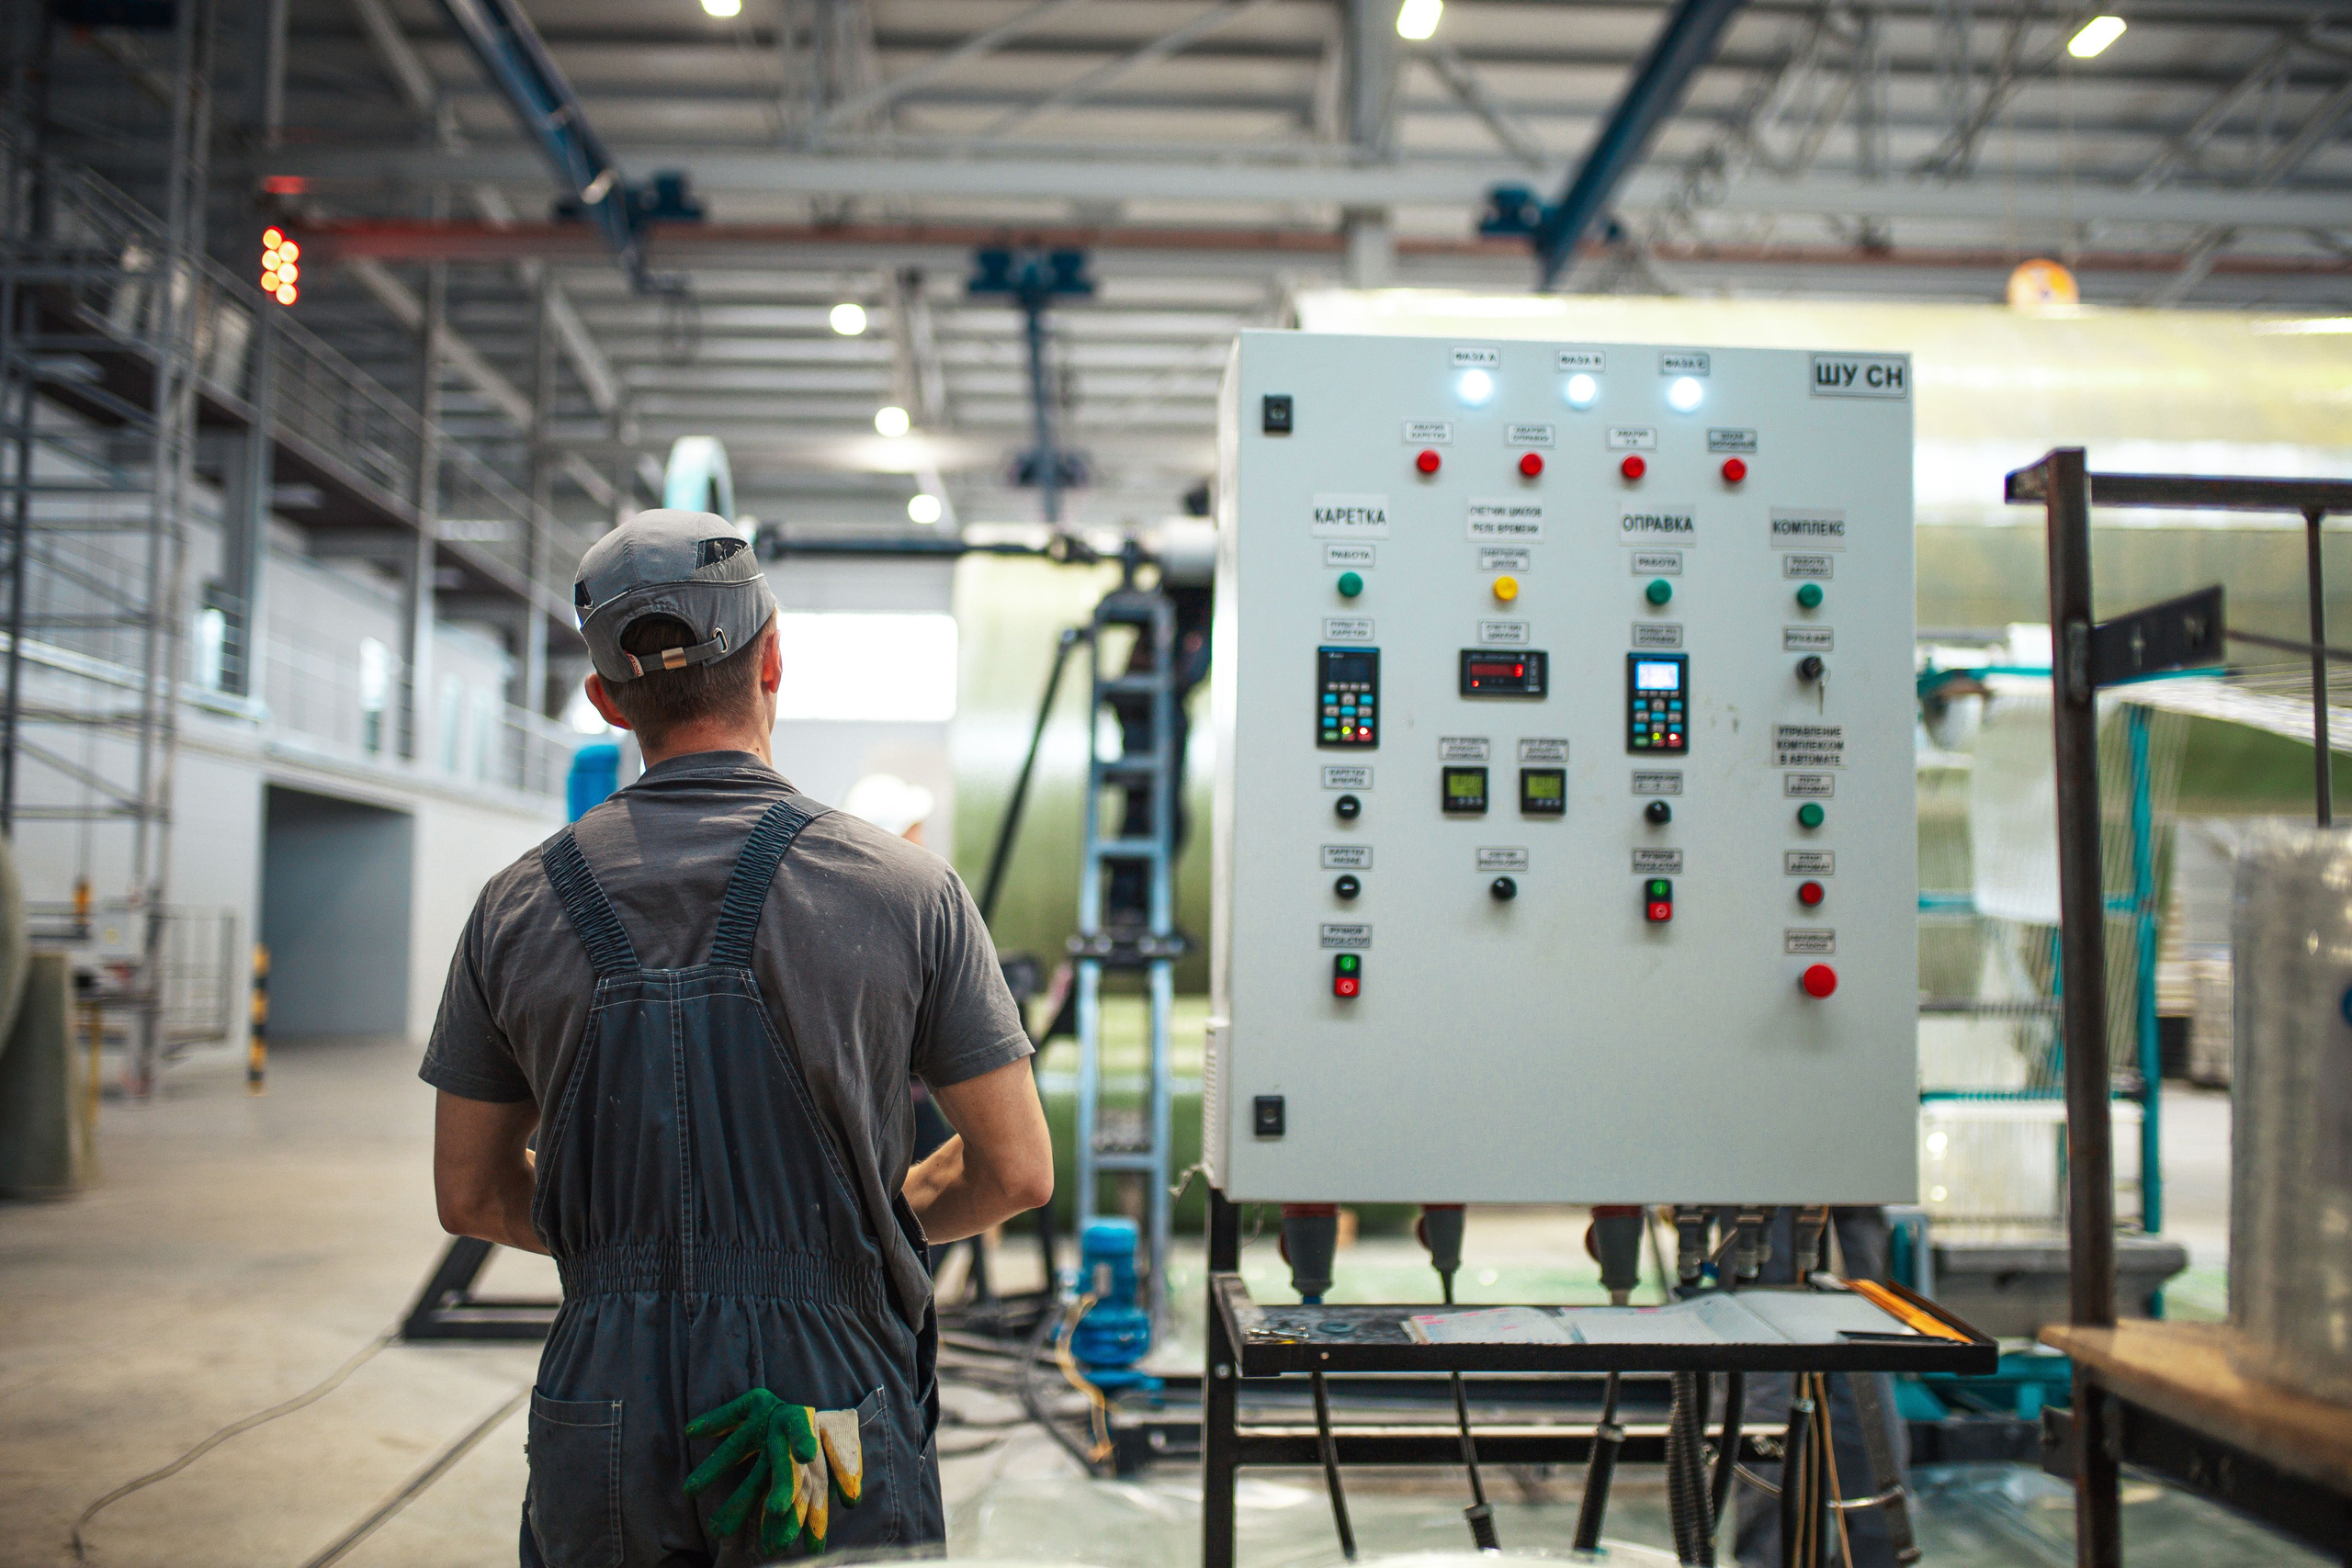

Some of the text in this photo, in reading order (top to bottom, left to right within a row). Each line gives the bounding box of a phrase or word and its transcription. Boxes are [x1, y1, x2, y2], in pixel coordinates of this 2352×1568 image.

[1815, 362, 1904, 388] ШУ СН
[1314, 506, 1386, 525] КАРЕТКА
[1623, 513, 1694, 533] ОПРАВКА
[1772, 520, 1845, 536] КОМПЛЕКС
[1330, 550, 1370, 559] РАБОТА
[1639, 558, 1678, 568] РАБОТА
[1779, 725, 1842, 737] УПРАВЛЕНИЕ
[1777, 739, 1844, 750] КОМПЛЕКСОМ
[1781, 752, 1841, 764] В АВТОМАТЕ
